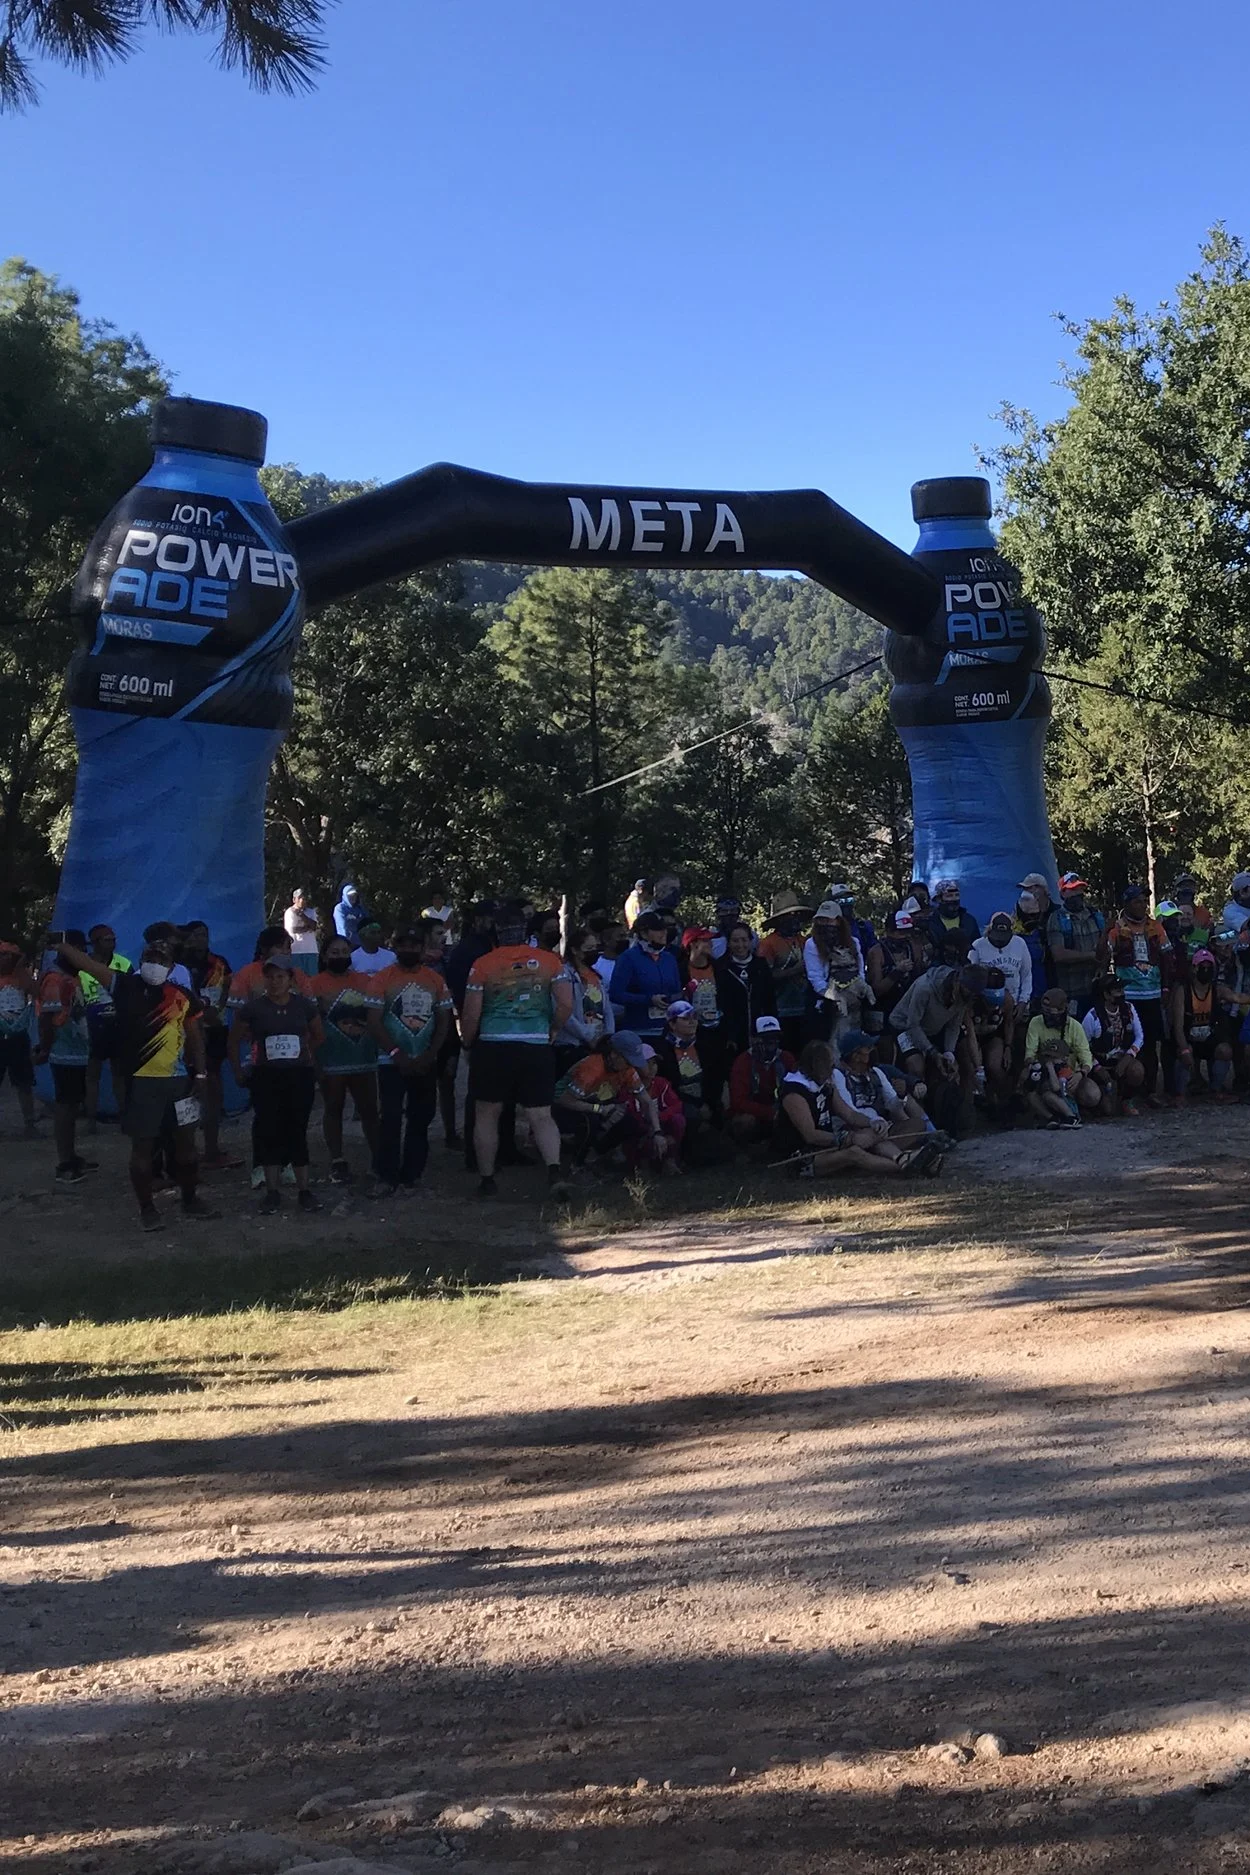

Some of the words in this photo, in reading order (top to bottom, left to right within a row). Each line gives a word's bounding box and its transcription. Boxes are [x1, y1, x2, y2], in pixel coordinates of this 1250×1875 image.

[567, 496, 745, 552] META
[116, 529, 299, 590] POWER
[105, 567, 228, 619] ADE
[102, 616, 153, 639] MORAS
[947, 609, 1029, 642] ADE
[119, 674, 150, 694] 600
[153, 680, 173, 697] ml
[971, 692, 994, 707] 600
[997, 690, 1011, 704] ml
